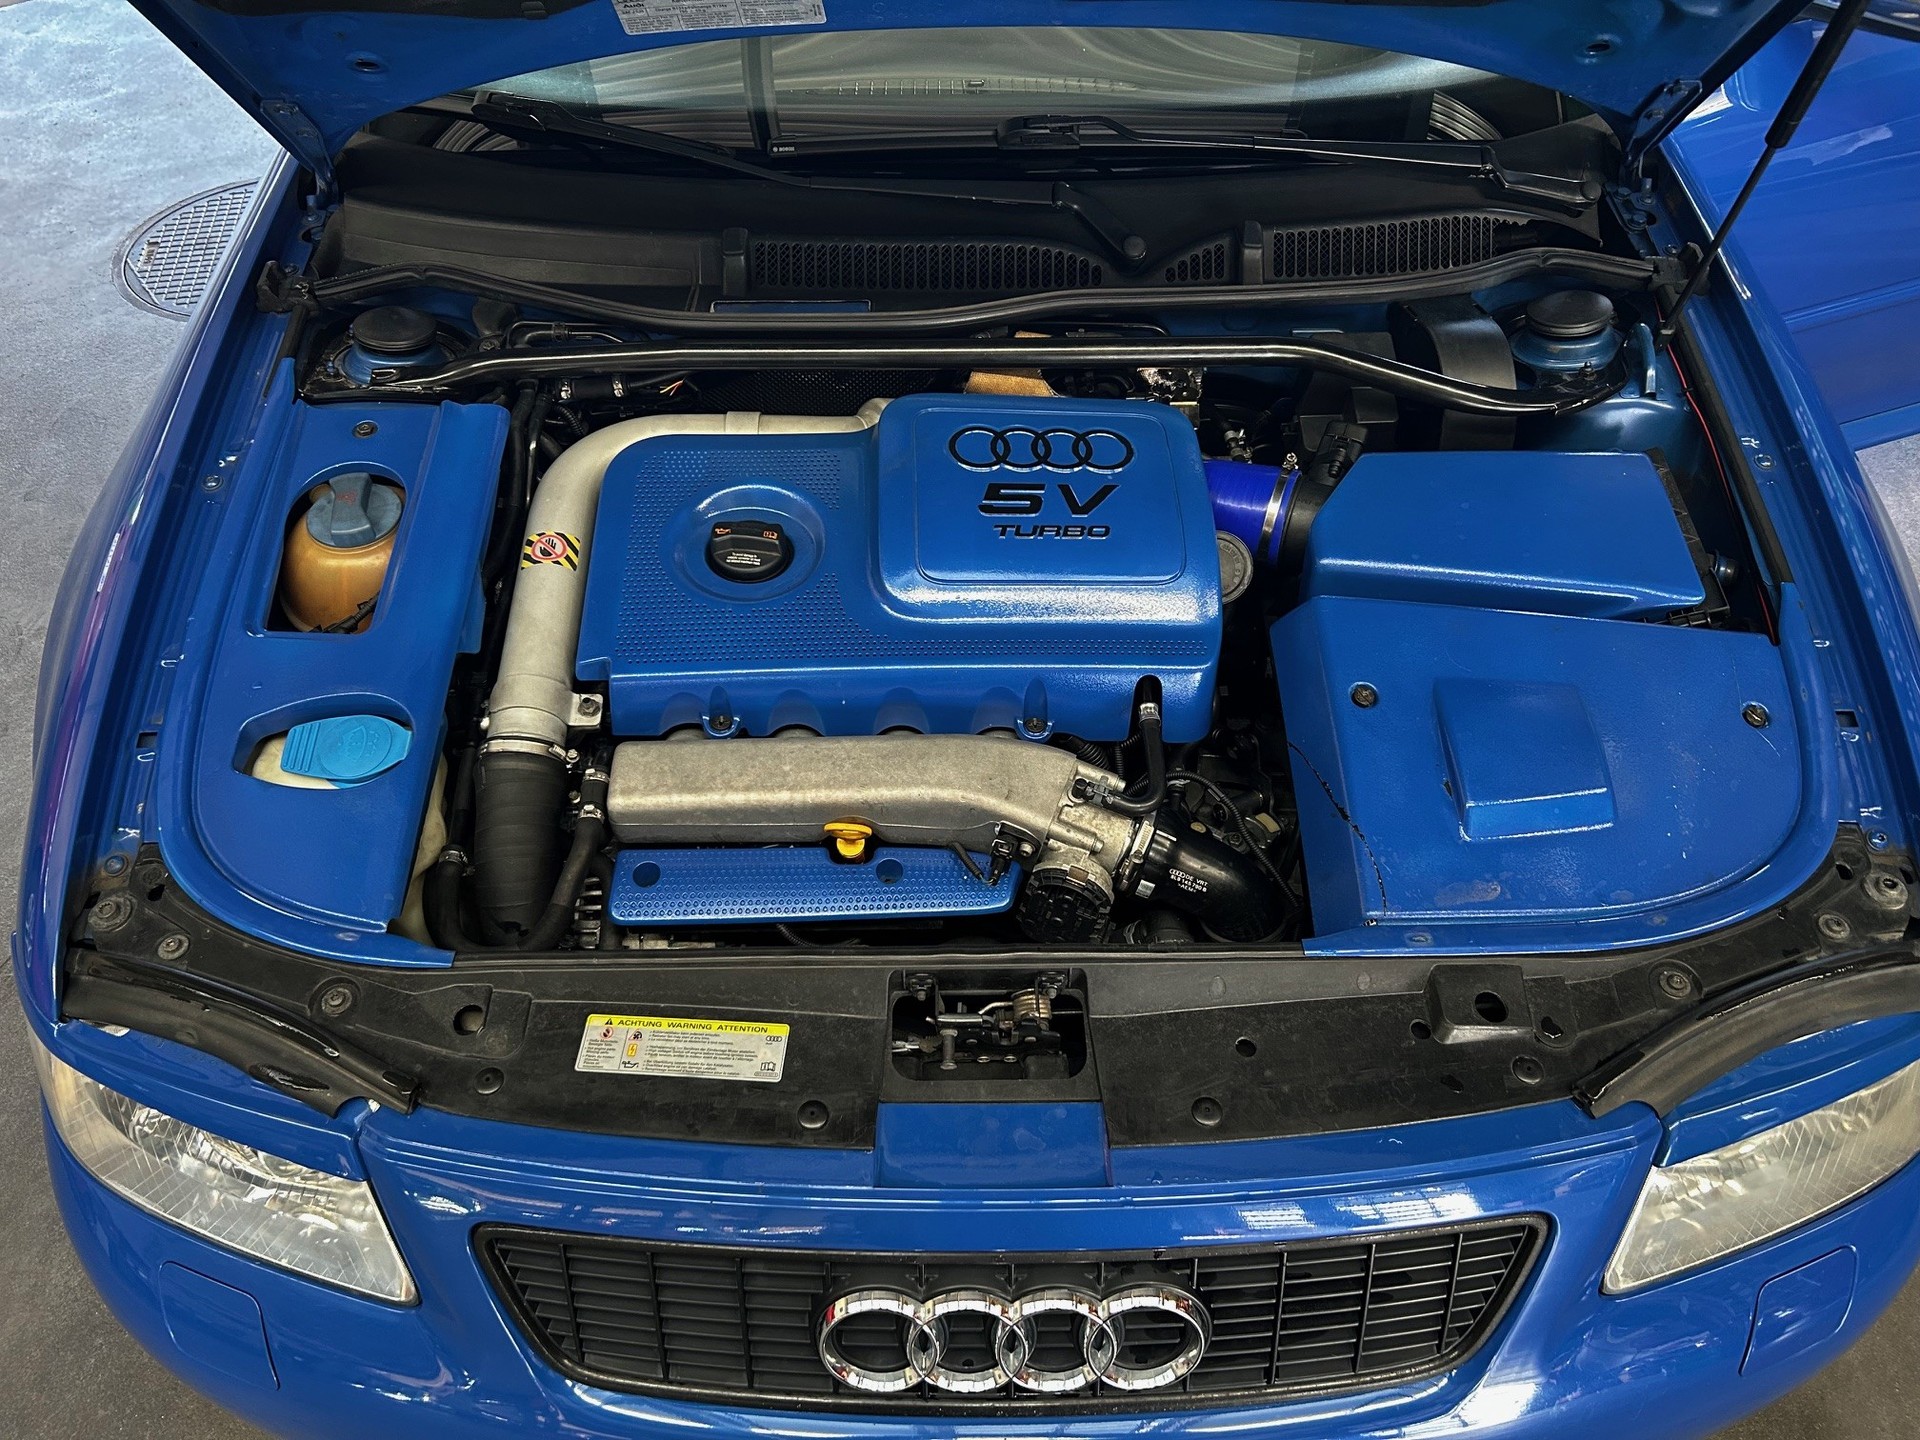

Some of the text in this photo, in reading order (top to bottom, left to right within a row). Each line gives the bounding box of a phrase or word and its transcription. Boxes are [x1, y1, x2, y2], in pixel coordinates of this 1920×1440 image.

[993, 524, 1111, 540] TURBO
[617, 1019, 662, 1028] ACHTUNG
[667, 1022, 712, 1030] WARNING
[717, 1024, 769, 1033] ATTENTION
